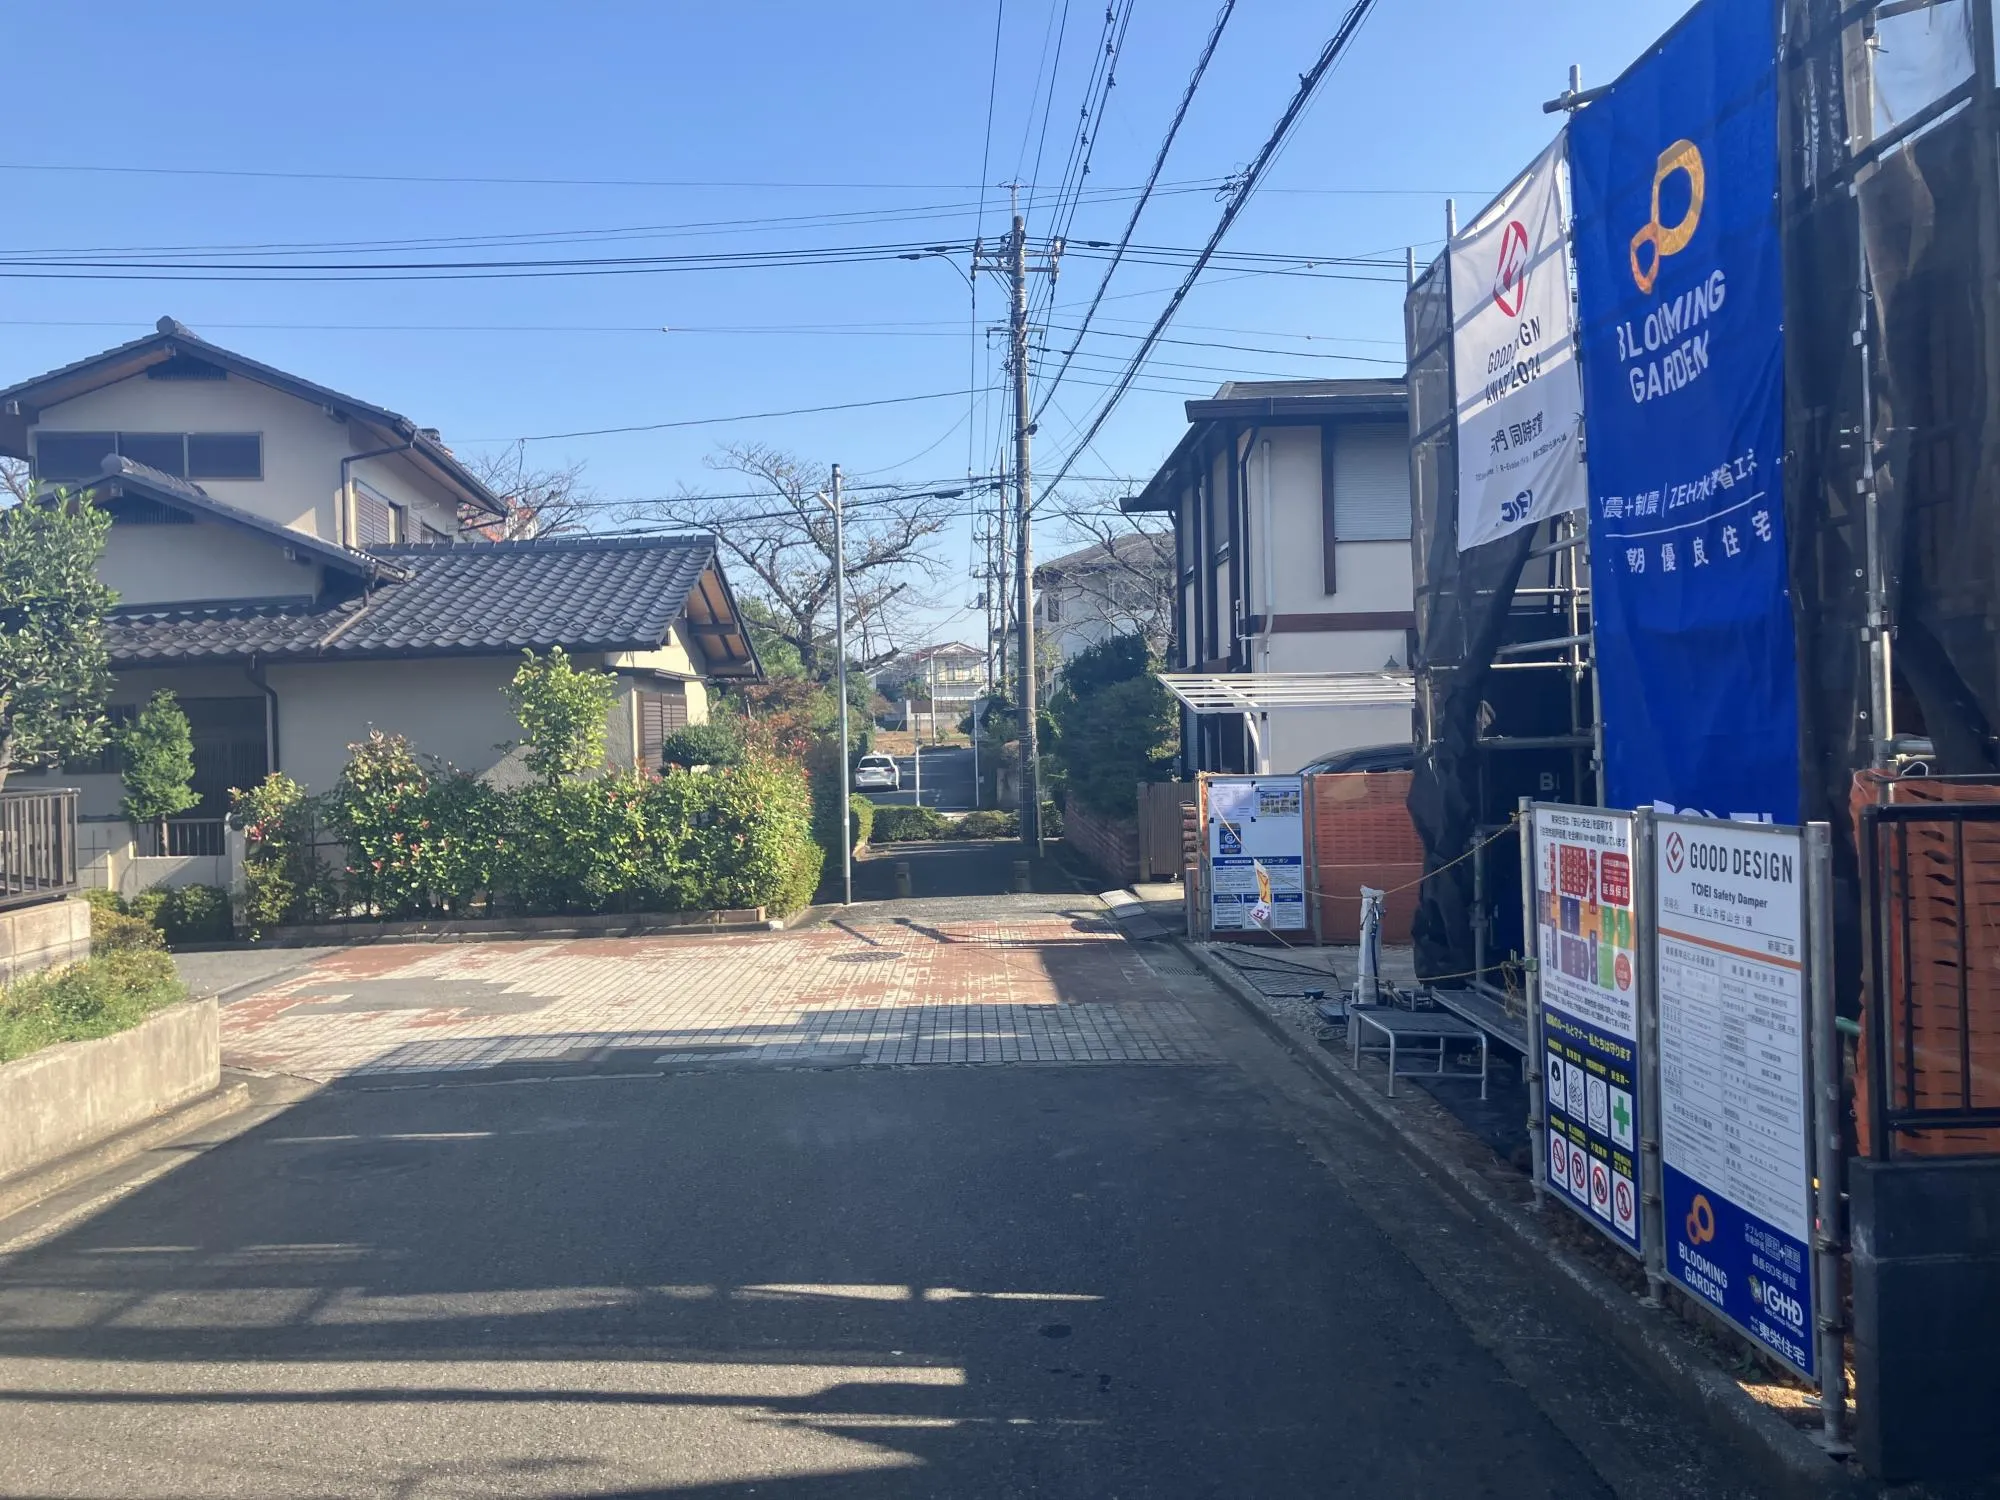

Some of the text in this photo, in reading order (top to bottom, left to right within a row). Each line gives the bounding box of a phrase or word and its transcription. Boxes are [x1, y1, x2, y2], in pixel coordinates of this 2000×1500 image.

[1488, 344, 1512, 375] GOOD
[1629, 329, 1709, 404] GARDEN
[1608, 509, 1772, 574] 期優良住宅
[1690, 842, 1792, 883] GOOD DESIGN
[1714, 888, 1735, 903] Safety
[1738, 892, 1767, 910] Damper
[1679, 1242, 1727, 1289] BLOOMING
[1685, 1265, 1723, 1306] GARDEN
[1759, 1321, 1805, 1367] 東栄住宅
